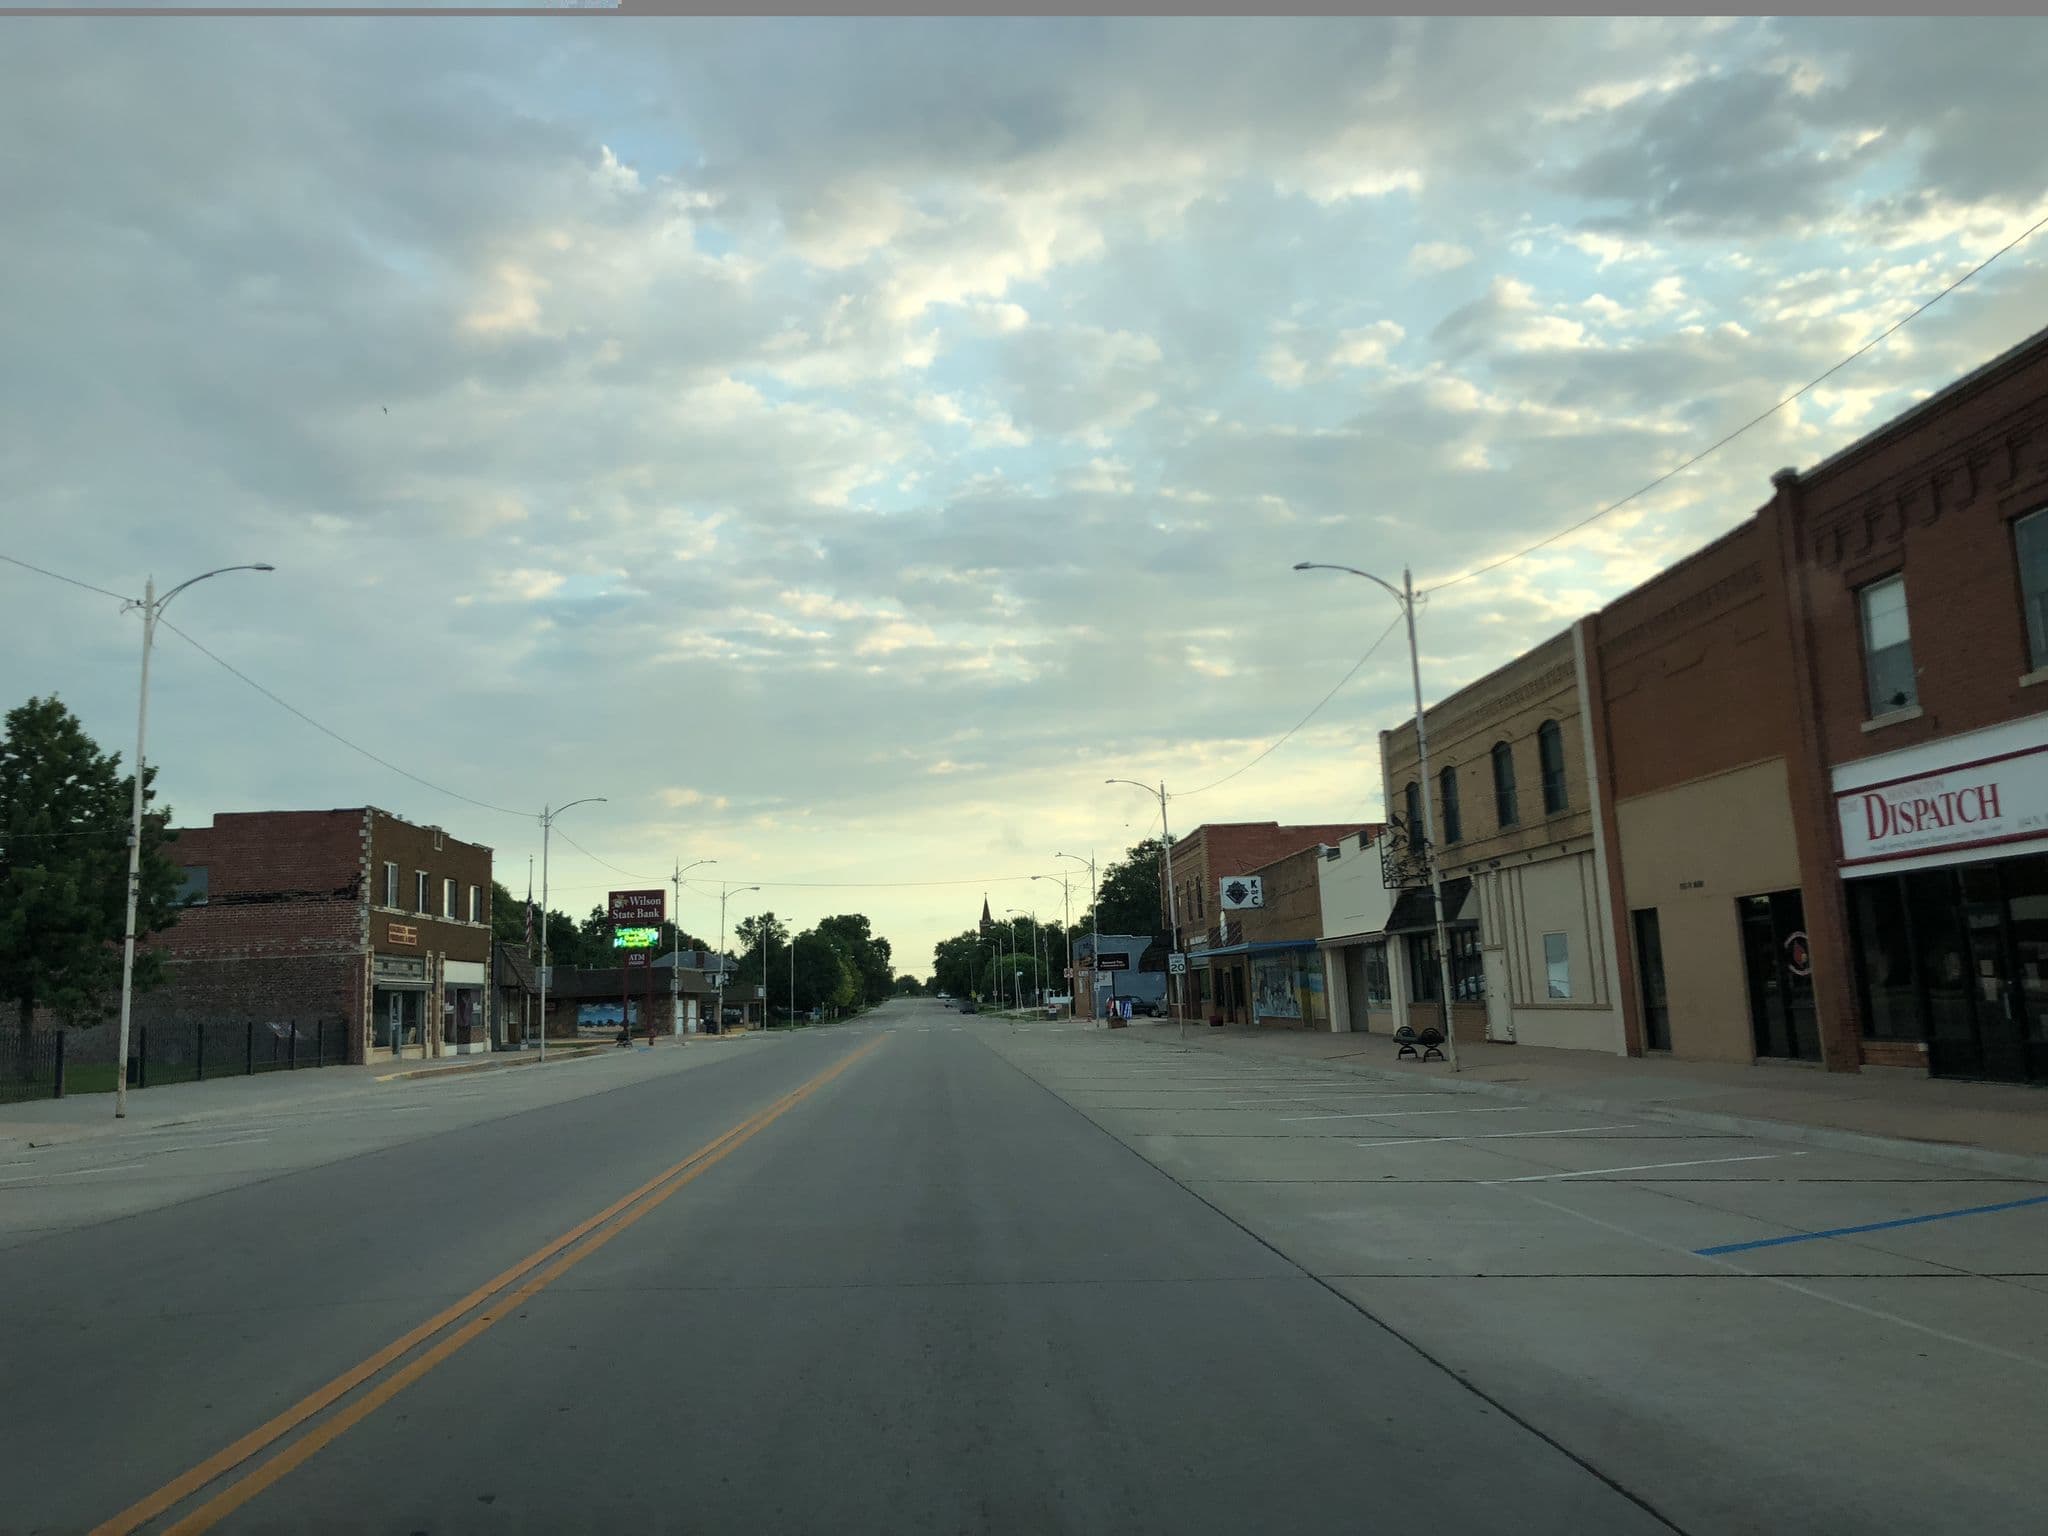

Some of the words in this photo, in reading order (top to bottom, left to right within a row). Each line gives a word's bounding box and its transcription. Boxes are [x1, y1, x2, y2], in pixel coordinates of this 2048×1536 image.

[1863, 783, 2002, 840] DISPATCH
[1250, 879, 1258, 889] K
[629, 895, 661, 906] Wilson
[1251, 895, 1259, 905] C
[612, 909, 635, 919] State
[637, 908, 660, 918] Bank
[629, 953, 645, 961] ATM
[1171, 964, 1185, 972] 20
